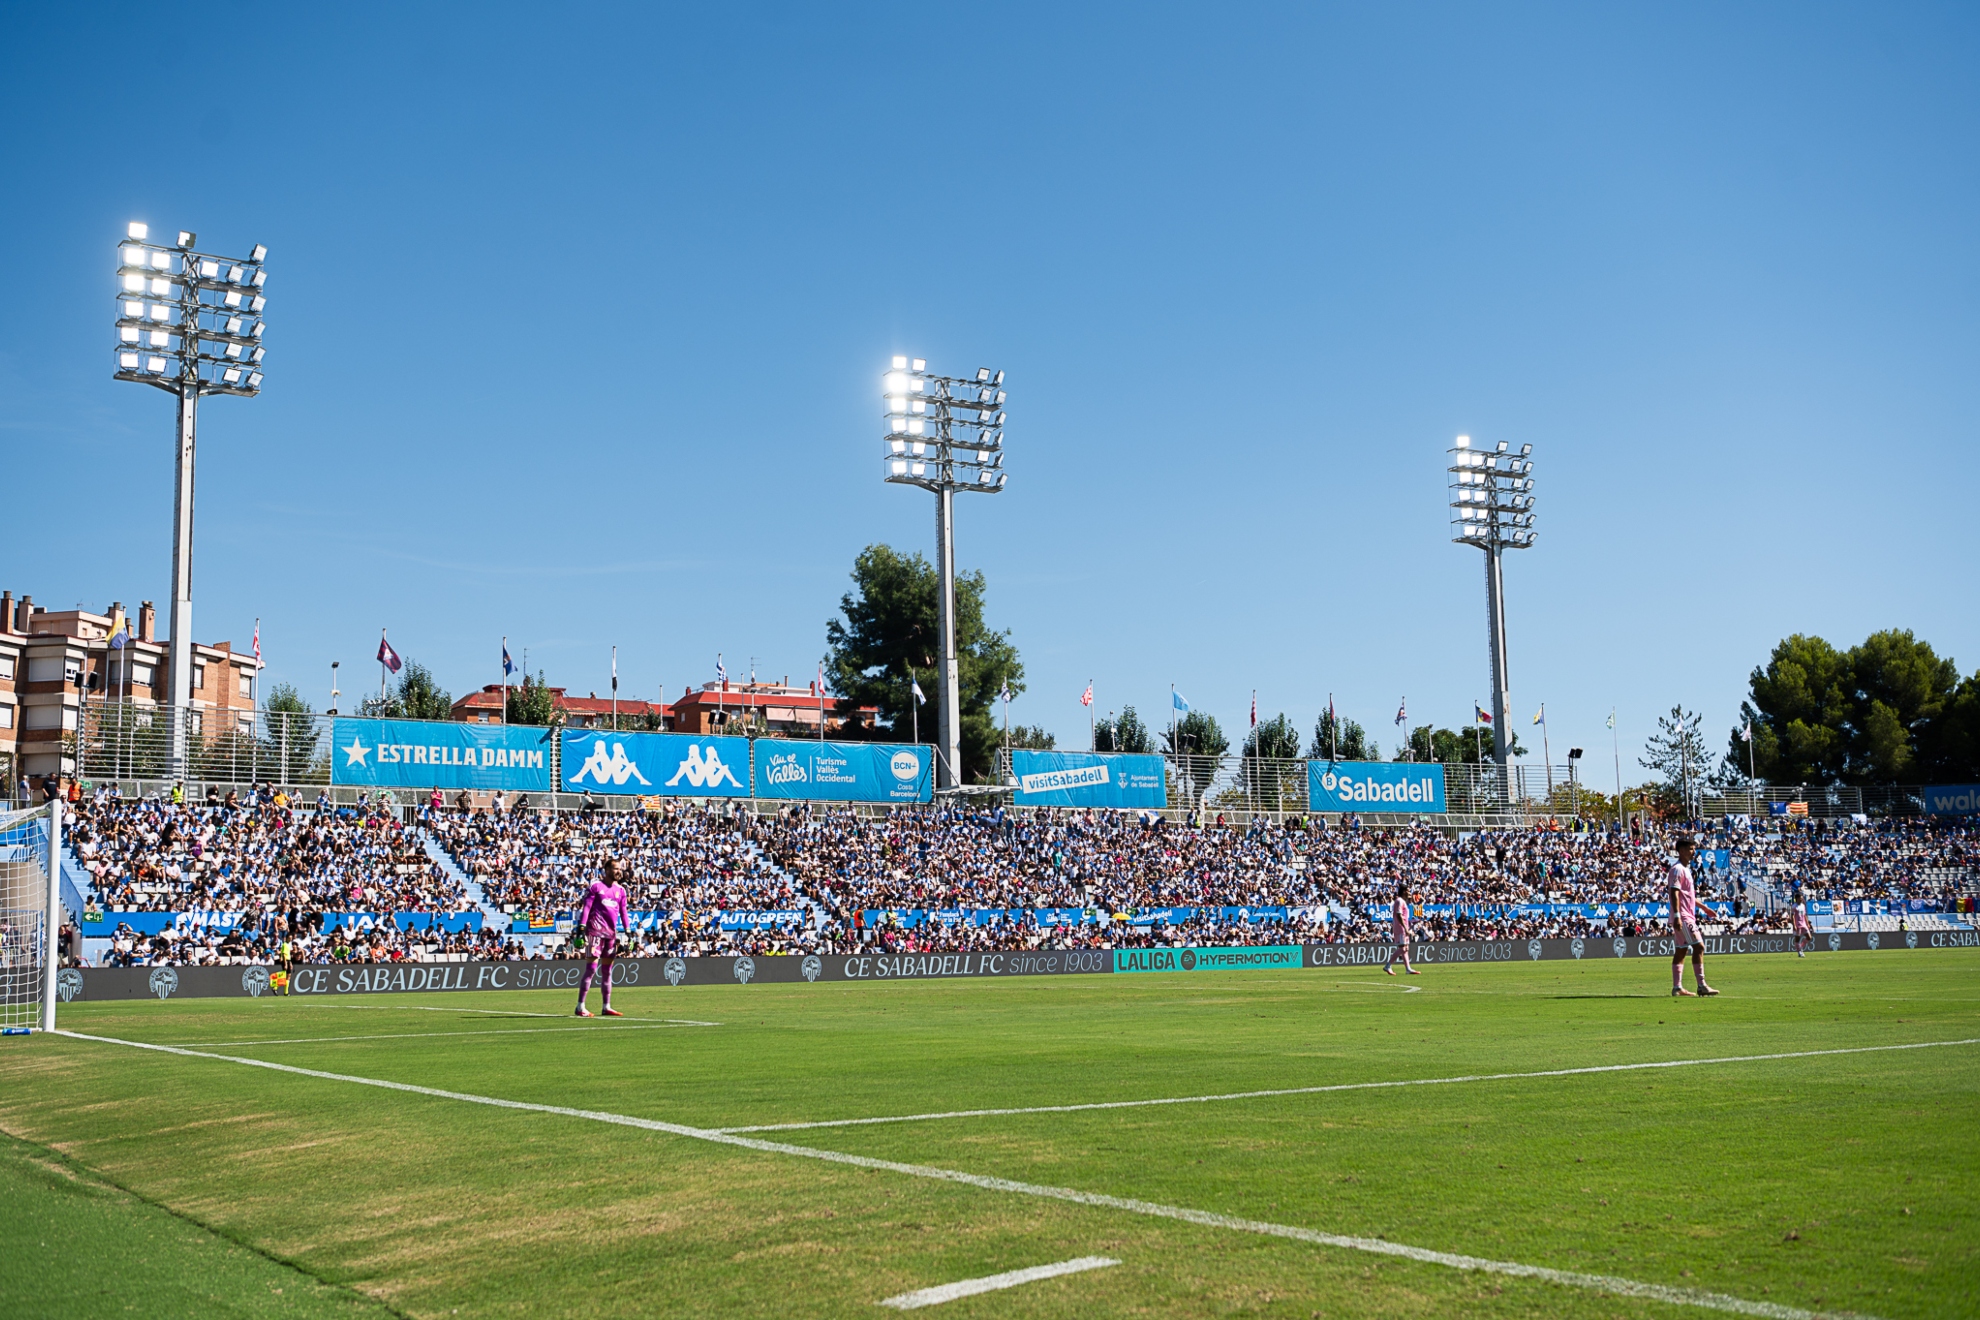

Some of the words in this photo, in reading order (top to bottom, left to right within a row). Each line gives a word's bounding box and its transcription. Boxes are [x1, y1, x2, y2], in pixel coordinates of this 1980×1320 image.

[377, 743, 477, 766] ESTRELLA
[482, 748, 543, 769] DAMM
[816, 757, 847, 766] Turisme
[766, 763, 807, 785] Vallès
[816, 766, 839, 774] Vallès
[816, 774, 856, 783] Occidental
[1029, 769, 1103, 789] visitSabadell
[1338, 776, 1434, 802] Sabadell
[1638, 939, 1656, 956] CE
[1729, 937, 1747, 953] FC
[1750, 937, 1783, 952] since
[1931, 932, 1947, 947] CE
[1118, 952, 1176, 970] LALIGA
[1312, 947, 1333, 965] CE
[1336, 946, 1412, 964] SABADE
[1416, 945, 1435, 962] FC
[1439, 944, 1476, 962] since
[1481, 943, 1512, 960] 1903
[844, 957, 871, 977] CE
[875, 956, 974, 977] SABADELL
[979, 954, 1004, 974] FC
[1009, 953, 1058, 973] since
[1063, 952, 1104, 972] 1903
[294, 969, 331, 993] CE
[336, 966, 469, 992] SABADELL
[476, 965, 509, 988] FC
[516, 964, 580, 987] since
